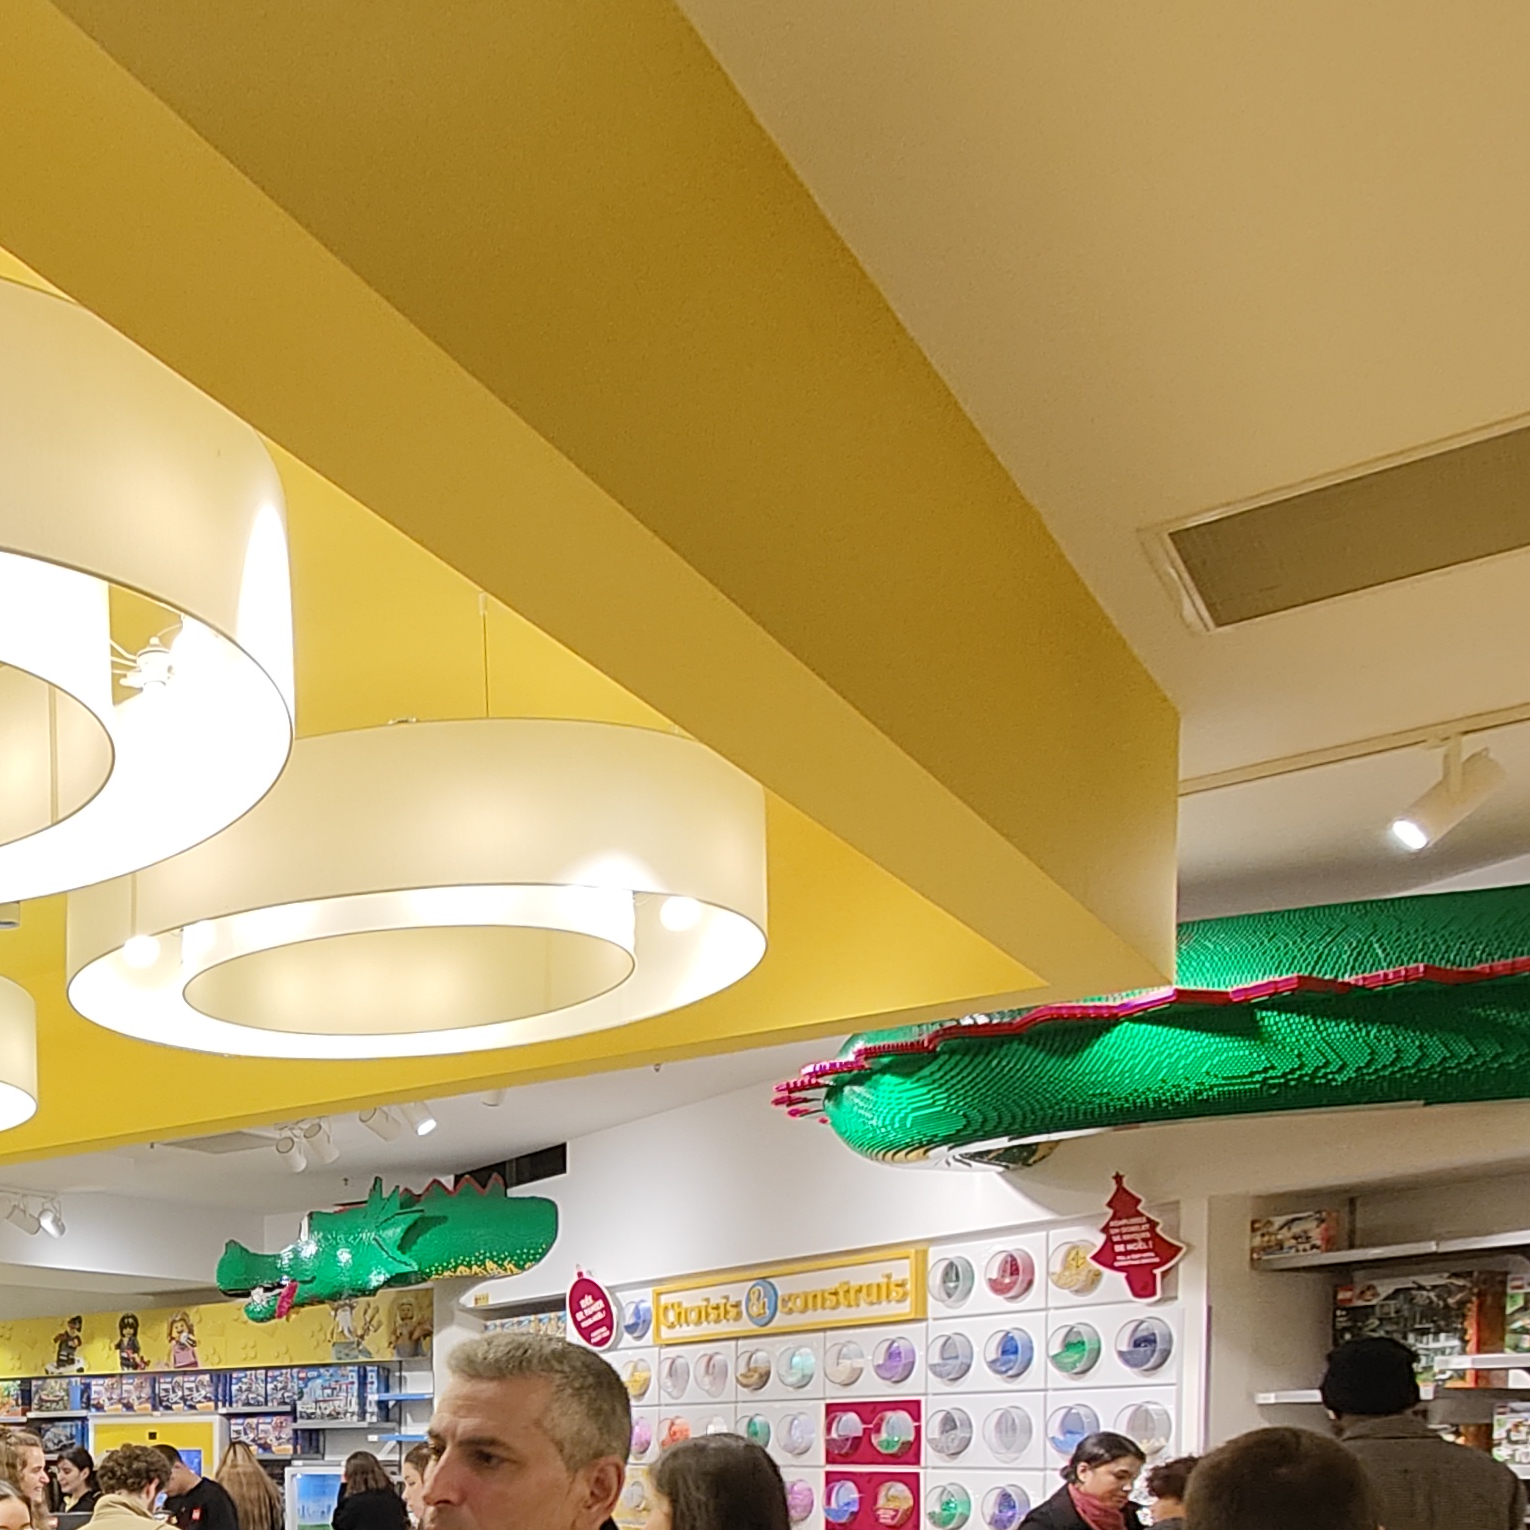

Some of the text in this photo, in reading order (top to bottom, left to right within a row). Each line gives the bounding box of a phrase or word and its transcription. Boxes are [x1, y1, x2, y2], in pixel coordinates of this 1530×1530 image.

[661, 1272, 908, 1329] Choisis & construis
